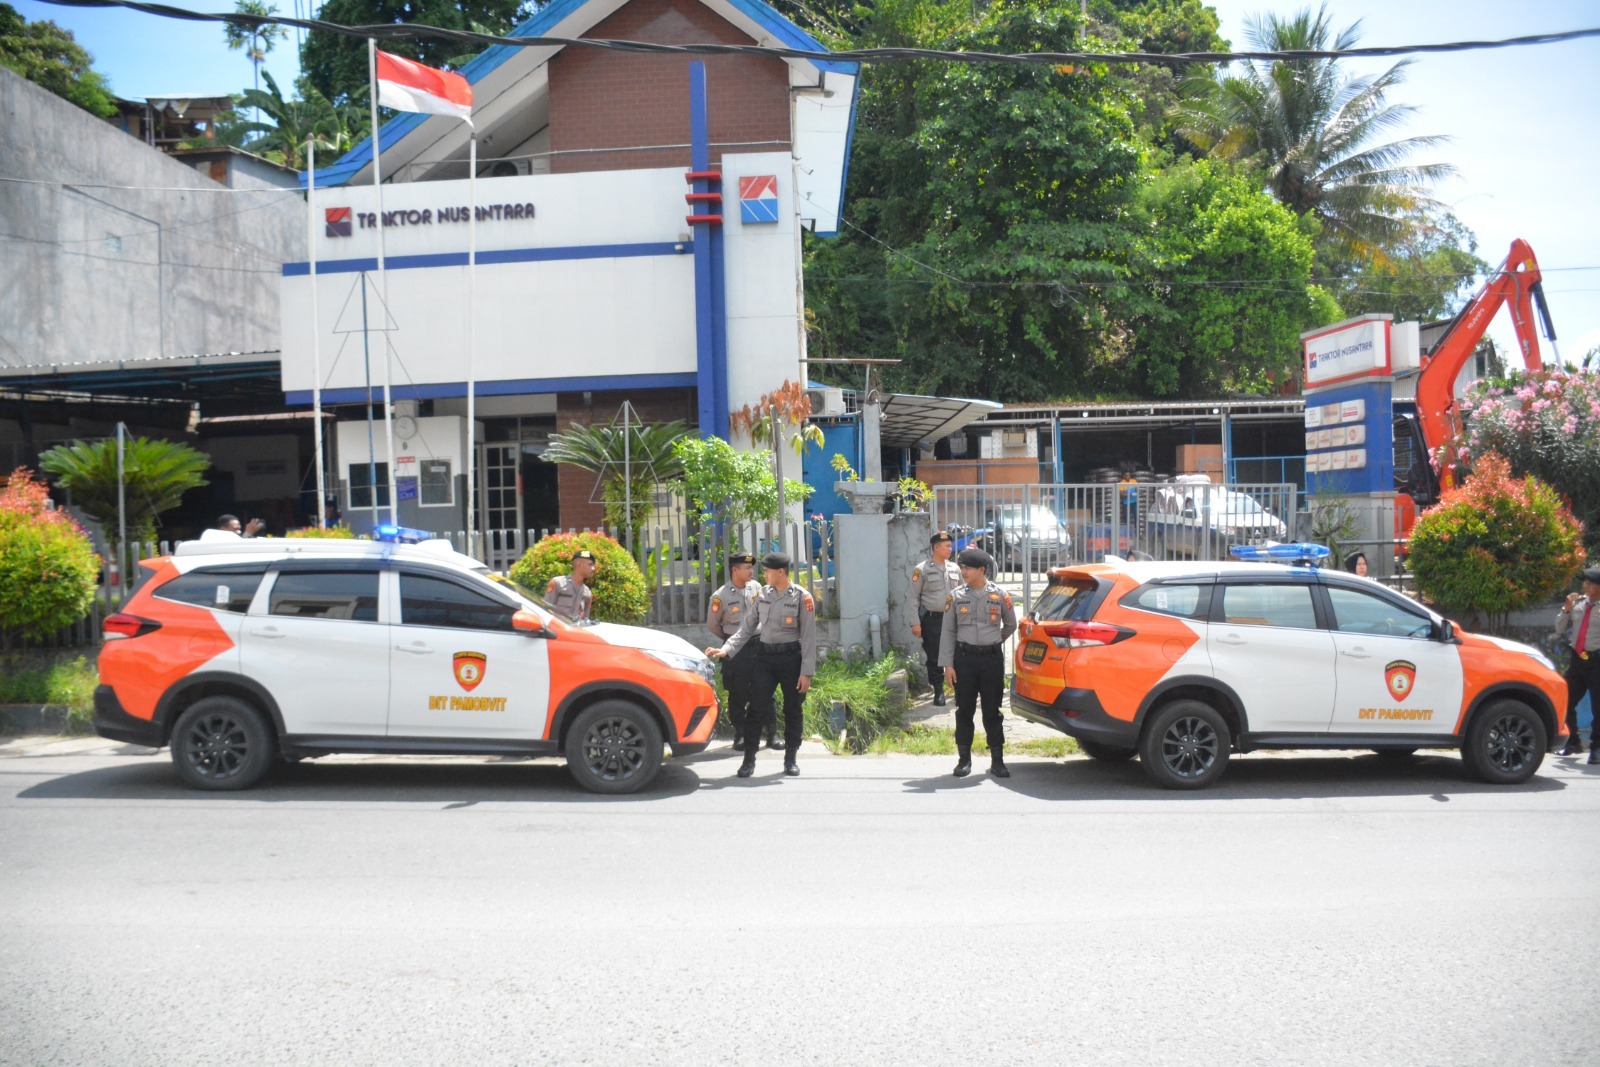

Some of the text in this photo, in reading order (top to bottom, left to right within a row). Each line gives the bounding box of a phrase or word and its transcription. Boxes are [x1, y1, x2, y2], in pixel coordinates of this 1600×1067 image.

[357, 202, 535, 229] TRAKTOR NUSANTARA
[1318, 341, 1373, 362] TRAKTOR NUSANTARA
[429, 695, 507, 711] DIT PAMOBVIT
[1359, 708, 1433, 720] DIT PAMOBVIT
